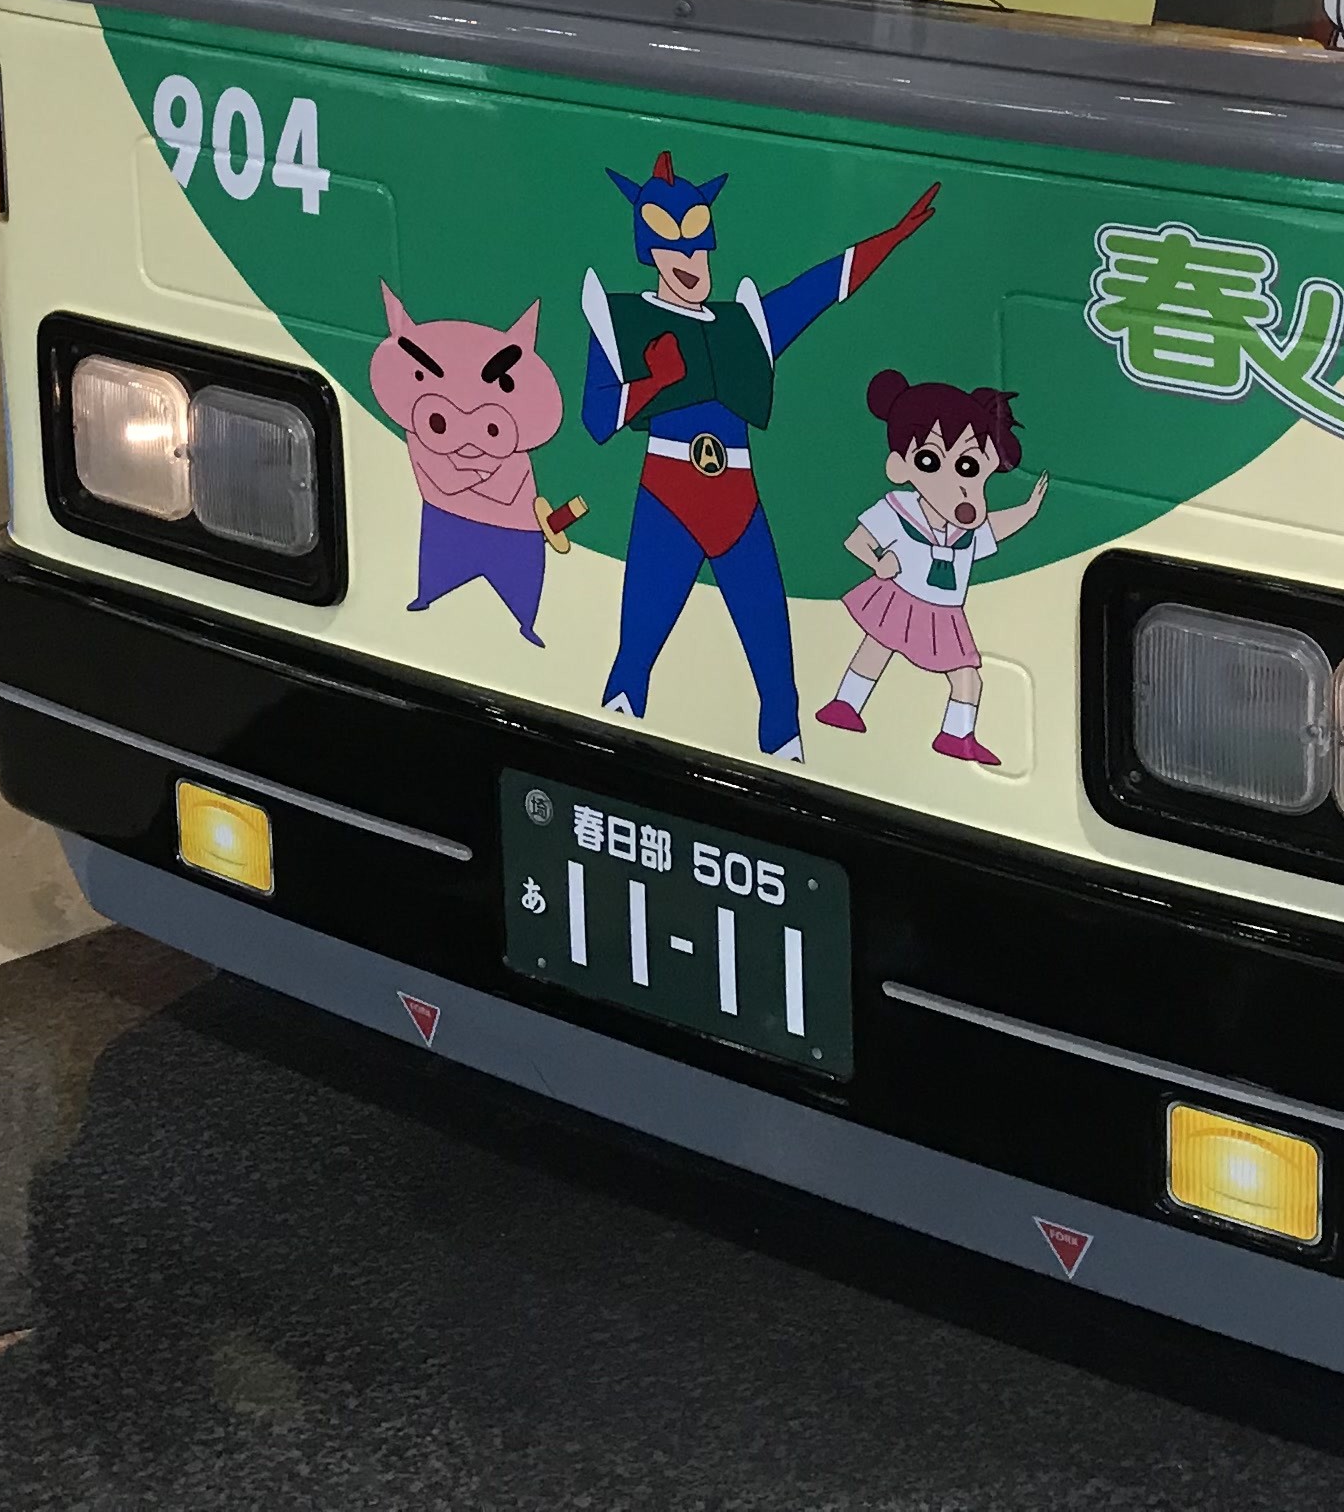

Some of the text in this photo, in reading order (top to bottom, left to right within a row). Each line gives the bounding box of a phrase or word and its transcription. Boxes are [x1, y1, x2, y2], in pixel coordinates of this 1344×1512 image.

[153, 74, 330, 215] 904
[521, 876, 546, 914] あ
[573, 804, 785, 906] 春日部 505
